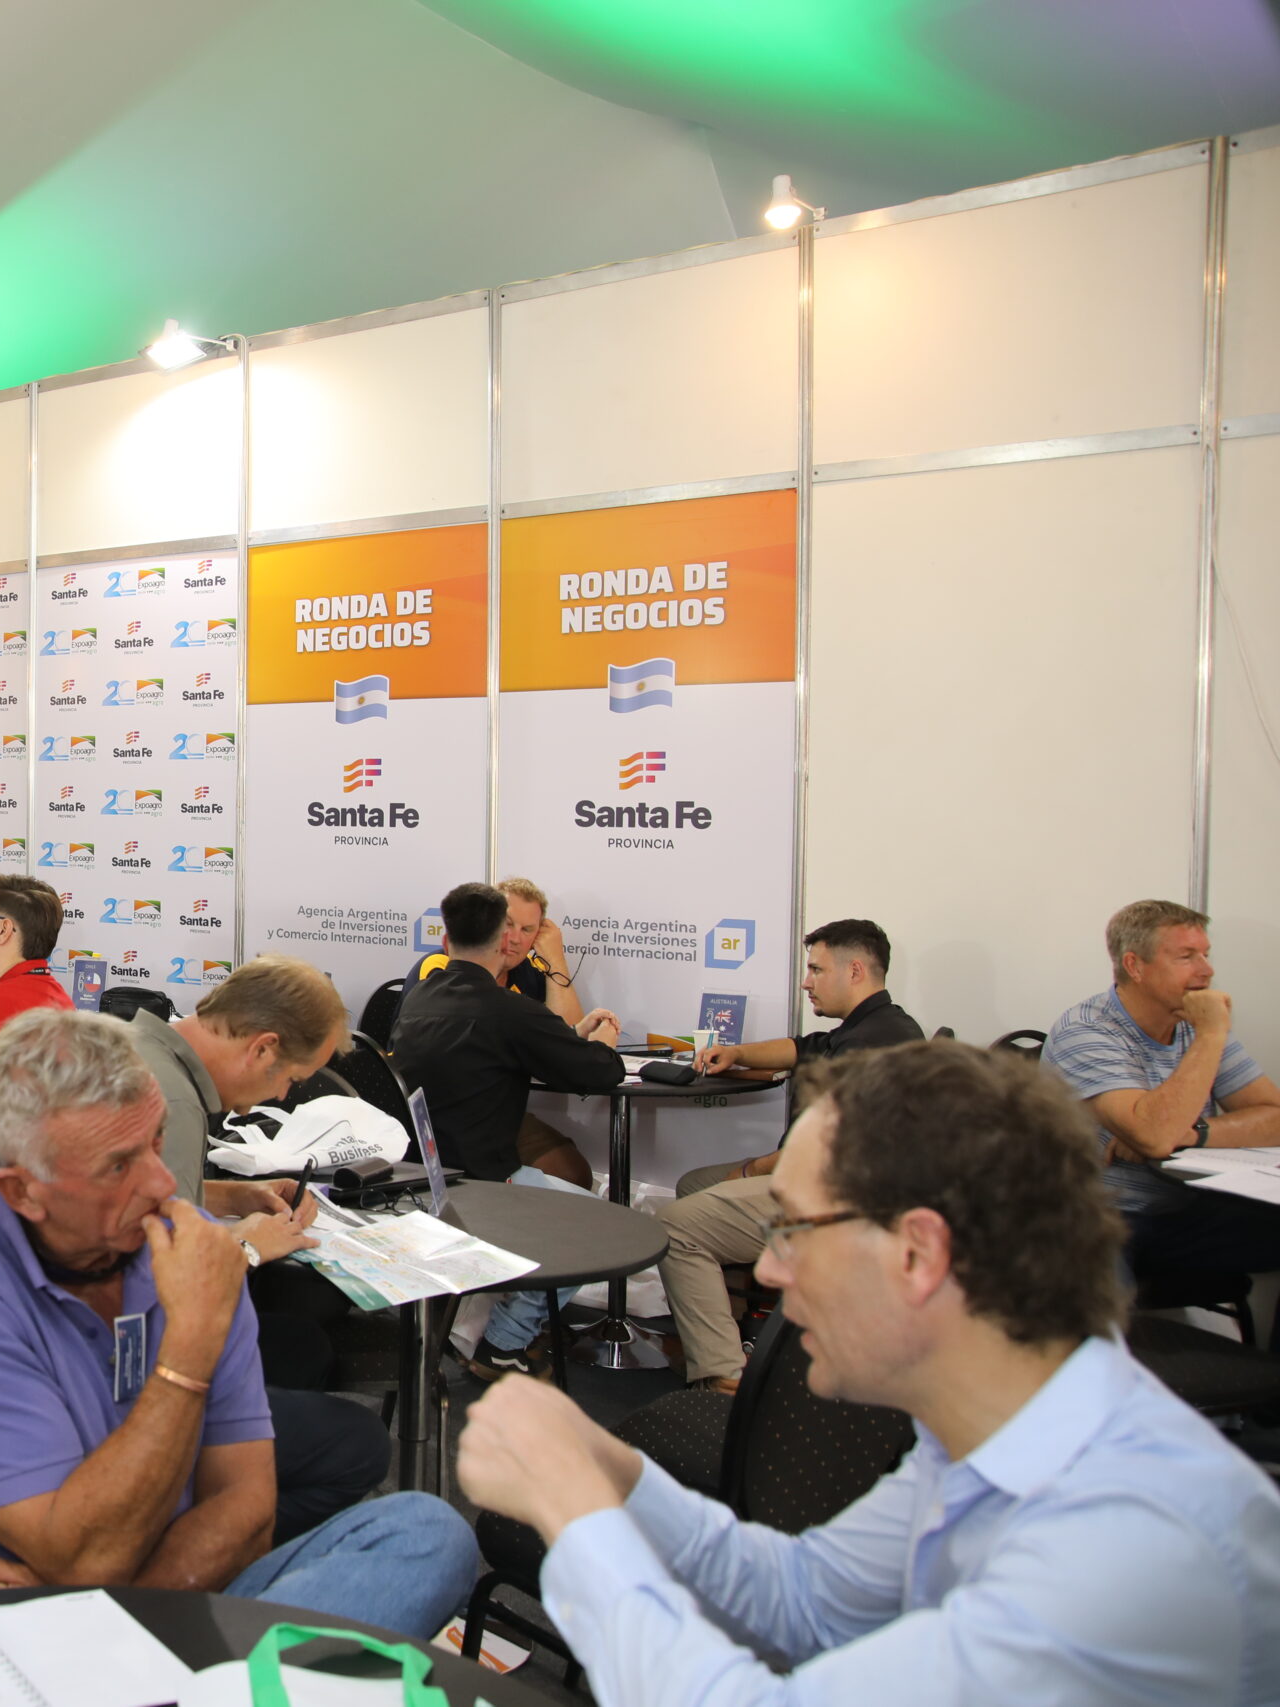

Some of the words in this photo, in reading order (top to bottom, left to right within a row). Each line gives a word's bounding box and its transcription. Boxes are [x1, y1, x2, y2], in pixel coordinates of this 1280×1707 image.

[138, 580, 165, 589] Expoagro
[184, 577, 213, 588] Santa
[215, 576, 226, 586] Fe
[559, 566, 673, 600] RONDA
[684, 562, 727, 591] DE
[9, 593, 18, 602] Fe
[52, 590, 77, 600] Santa
[78, 588, 88, 598] Fe
[296, 593, 388, 622] RONDA
[396, 590, 432, 616] DE
[561, 597, 725, 634] NEGOCIOS
[207, 631, 236, 640] Expoagro
[297, 621, 430, 652] NEGOCIOS
[3, 642, 27, 650] Expoagro
[115, 638, 142, 649] Santa
[144, 637, 154, 647] Fe
[8, 696, 17, 705] Fe
[50, 696, 75, 706] Santa
[77, 695, 86, 705] Fe
[136, 691, 164, 699] Expoagro
[182, 691, 211, 700] Santa
[213, 690, 224, 700] Fe
[113, 749, 140, 758] Santa
[142, 748, 152, 758] Fe
[8, 799, 17, 808] Fe
[49, 802, 74, 812] Santa
[76, 802, 85, 812] Fe
[181, 804, 209, 814] Santa
[212, 804, 223, 814] Fe
[308, 802, 384, 828] Santa
[390, 803, 419, 828] Fe
[574, 800, 669, 828] Santa
[676, 801, 712, 829] Fe
[335, 836, 388, 846] PROVINCIA
[608, 838, 674, 849] PROVINCIA
[3, 849, 26, 857] Expoagro
[112, 858, 139, 867] Santa
[141, 858, 151, 868] Fe
[75, 910, 84, 919] Fe
[134, 912, 161, 920] Expoagro
[298, 906, 344, 919] Agencia
[347, 908, 408, 922] Argentina
[179, 916, 208, 926] Santa
[210, 917, 221, 927] Fe
[321, 918, 336, 929] de
[339, 920, 408, 934] Inversiones
[562, 915, 619, 930] Agencia
[624, 918, 697, 934] Argentina
[427, 924, 443, 936] ar
[267, 929, 274, 939] y
[276, 928, 328, 941] Comercio
[331, 932, 408, 946] Internacional
[592, 931, 609, 943] de
[614, 932, 697, 948] Inversiones
[721, 937, 740, 950] ar
[603, 947, 697, 962] Internacional
[111, 966, 138, 976] Santa
[140, 968, 150, 978] Fe
[694, 1096, 728, 1108] agro
